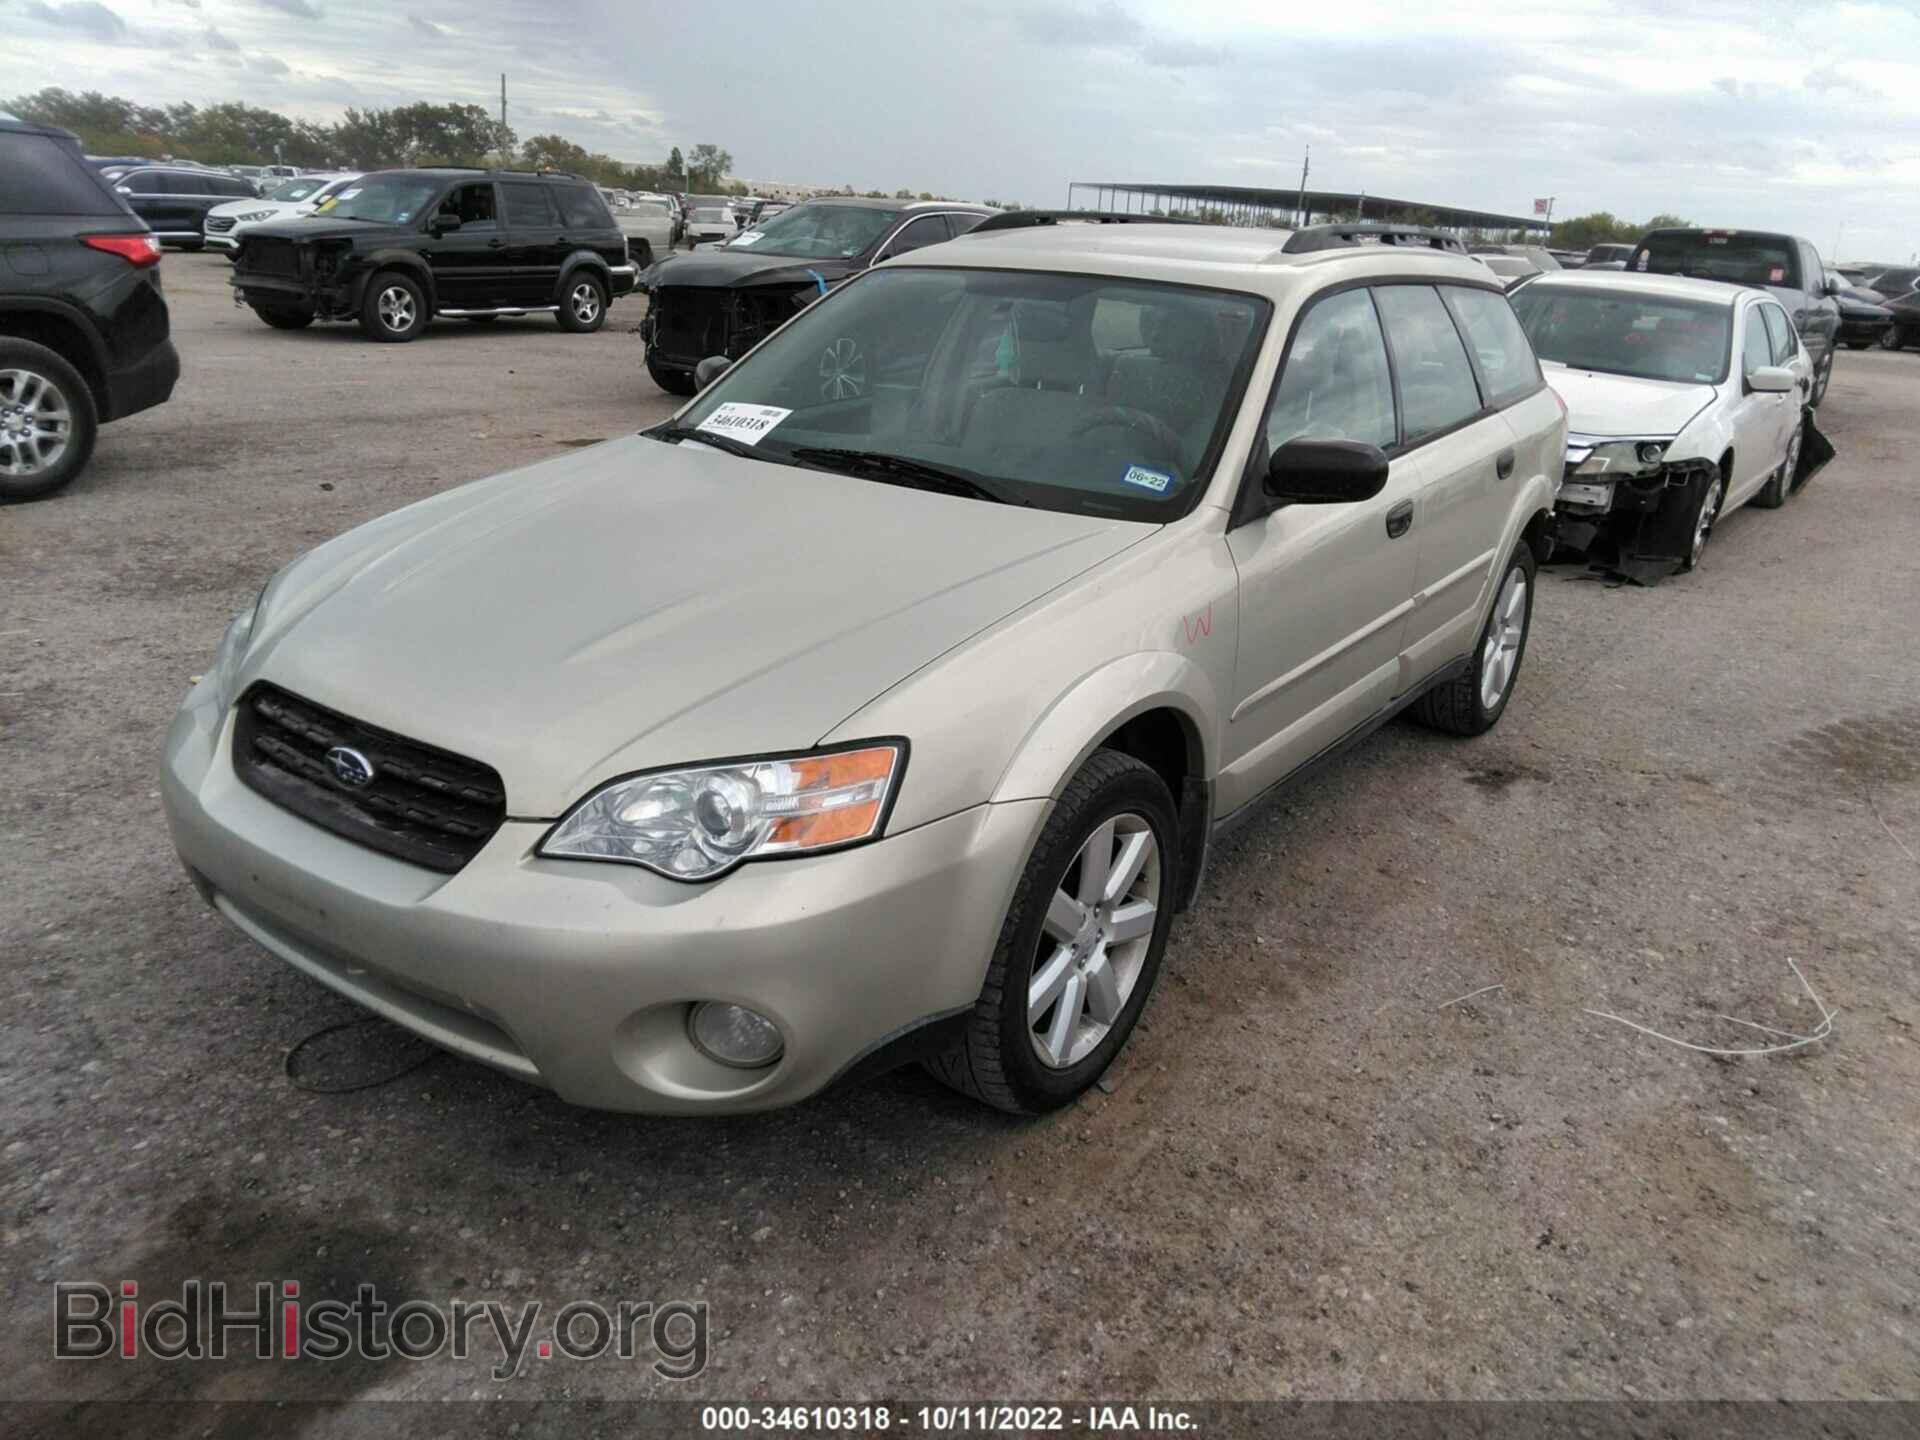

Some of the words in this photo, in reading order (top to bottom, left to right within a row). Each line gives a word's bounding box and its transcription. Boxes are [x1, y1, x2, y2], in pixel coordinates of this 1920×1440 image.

[708, 414, 769, 430] 34610318
[1128, 470, 1166, 488] 06-22
[1183, 600, 1213, 645] W
